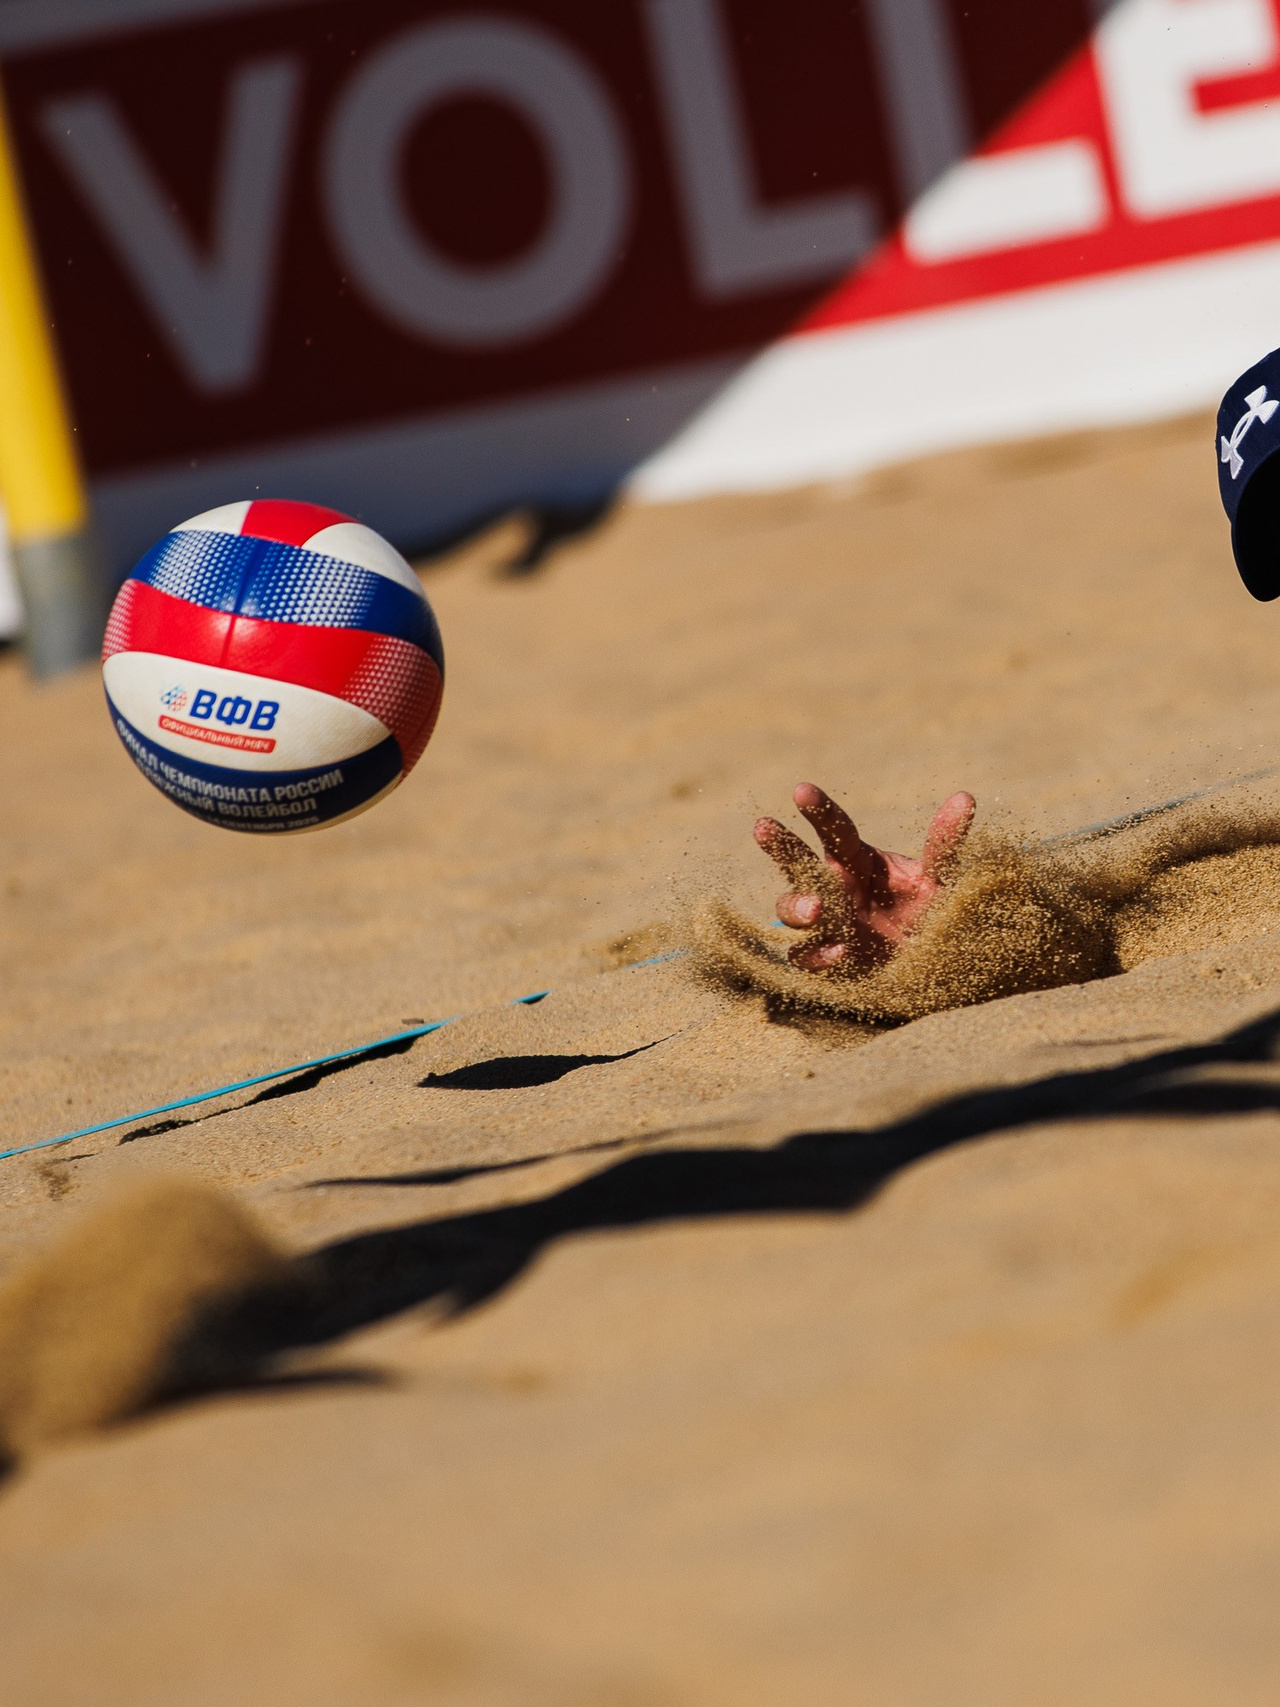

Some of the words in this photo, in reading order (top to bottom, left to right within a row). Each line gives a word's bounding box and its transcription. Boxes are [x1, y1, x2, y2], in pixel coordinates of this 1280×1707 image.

[189, 689, 279, 730] ВФВ
[161, 718, 244, 747] ОФИЦИАЛЬНЫЙ
[160, 761, 271, 803] ЧЕМПИОНАТА
[273, 768, 344, 801] РОССИИ
[217, 797, 318, 818] ВОЛЕЙБОЛ
